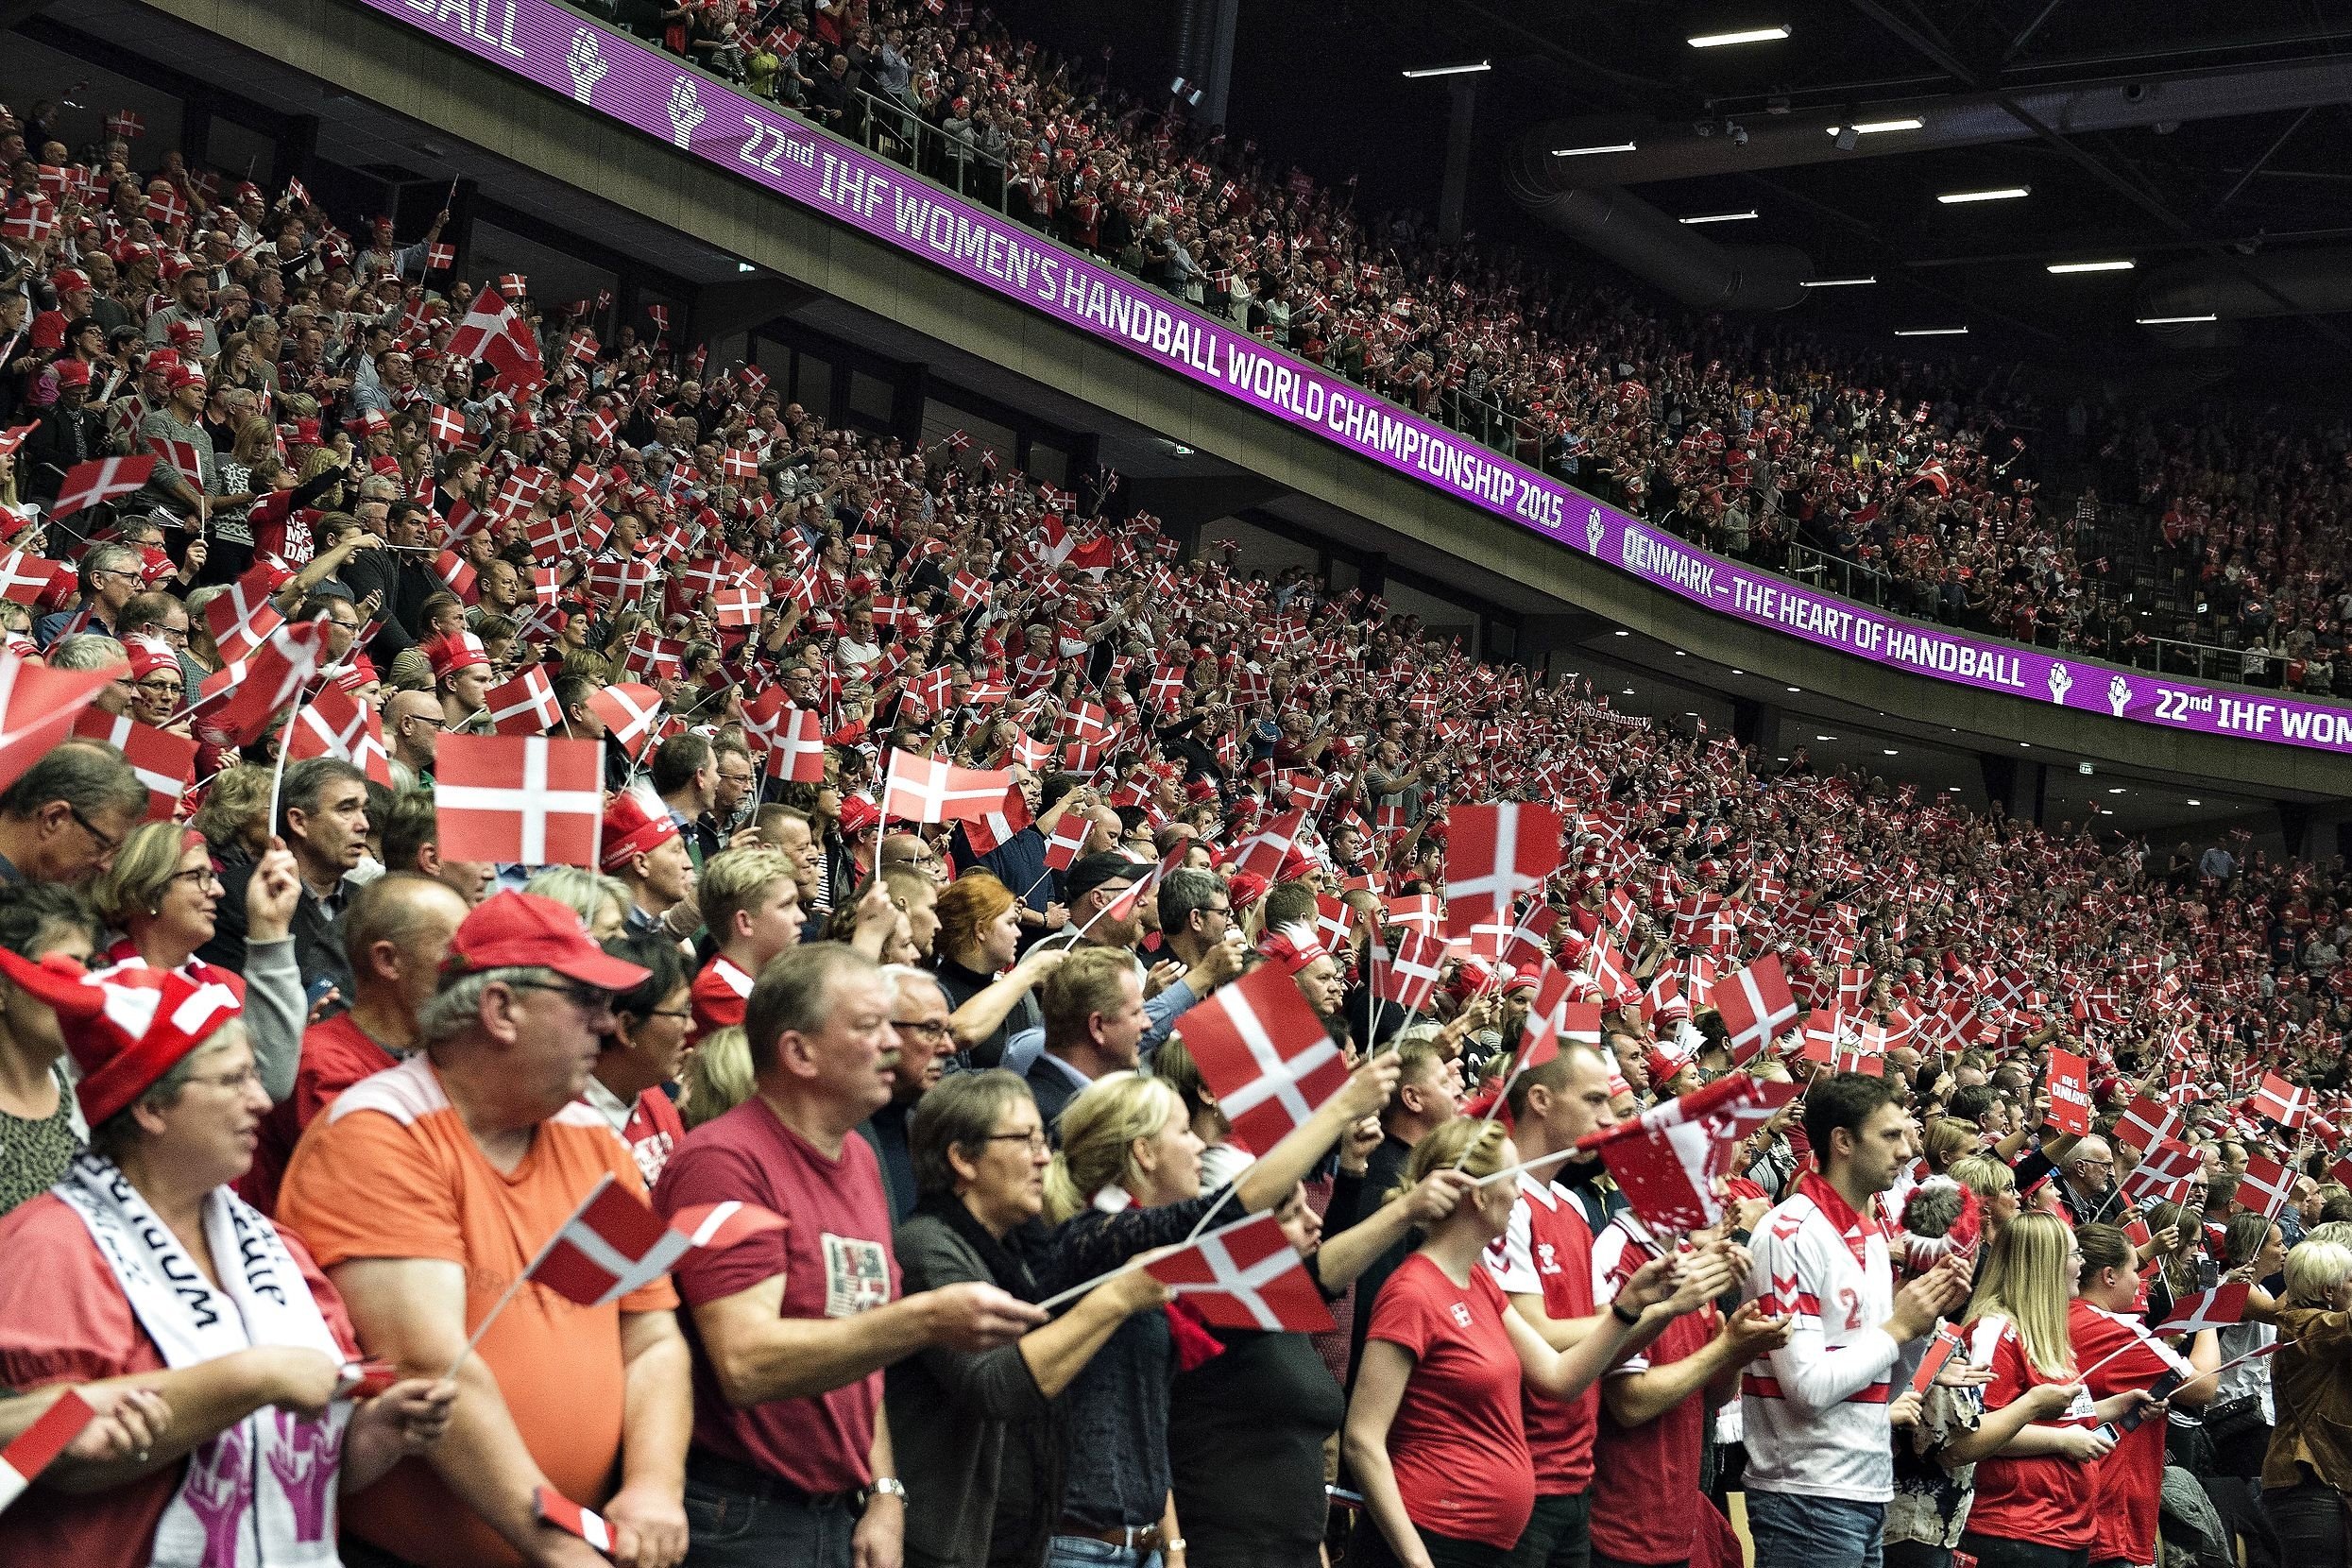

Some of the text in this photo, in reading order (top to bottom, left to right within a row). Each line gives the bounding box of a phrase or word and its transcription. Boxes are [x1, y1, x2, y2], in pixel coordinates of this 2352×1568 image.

[404, 0, 525, 59] ALL
[739, 114, 1565, 529] 22nd IHF WOMEN'S HANDBALL WORLD CHAMPIONSHIP 2015
[1732, 576, 1777, 619] THE
[1779, 592, 1853, 642] HEART
[1854, 619, 1884, 651] OF
[1886, 628, 2025, 688] HANDBALL
[2155, 689, 2212, 722] 22nd
[2217, 698, 2275, 733] IHF
